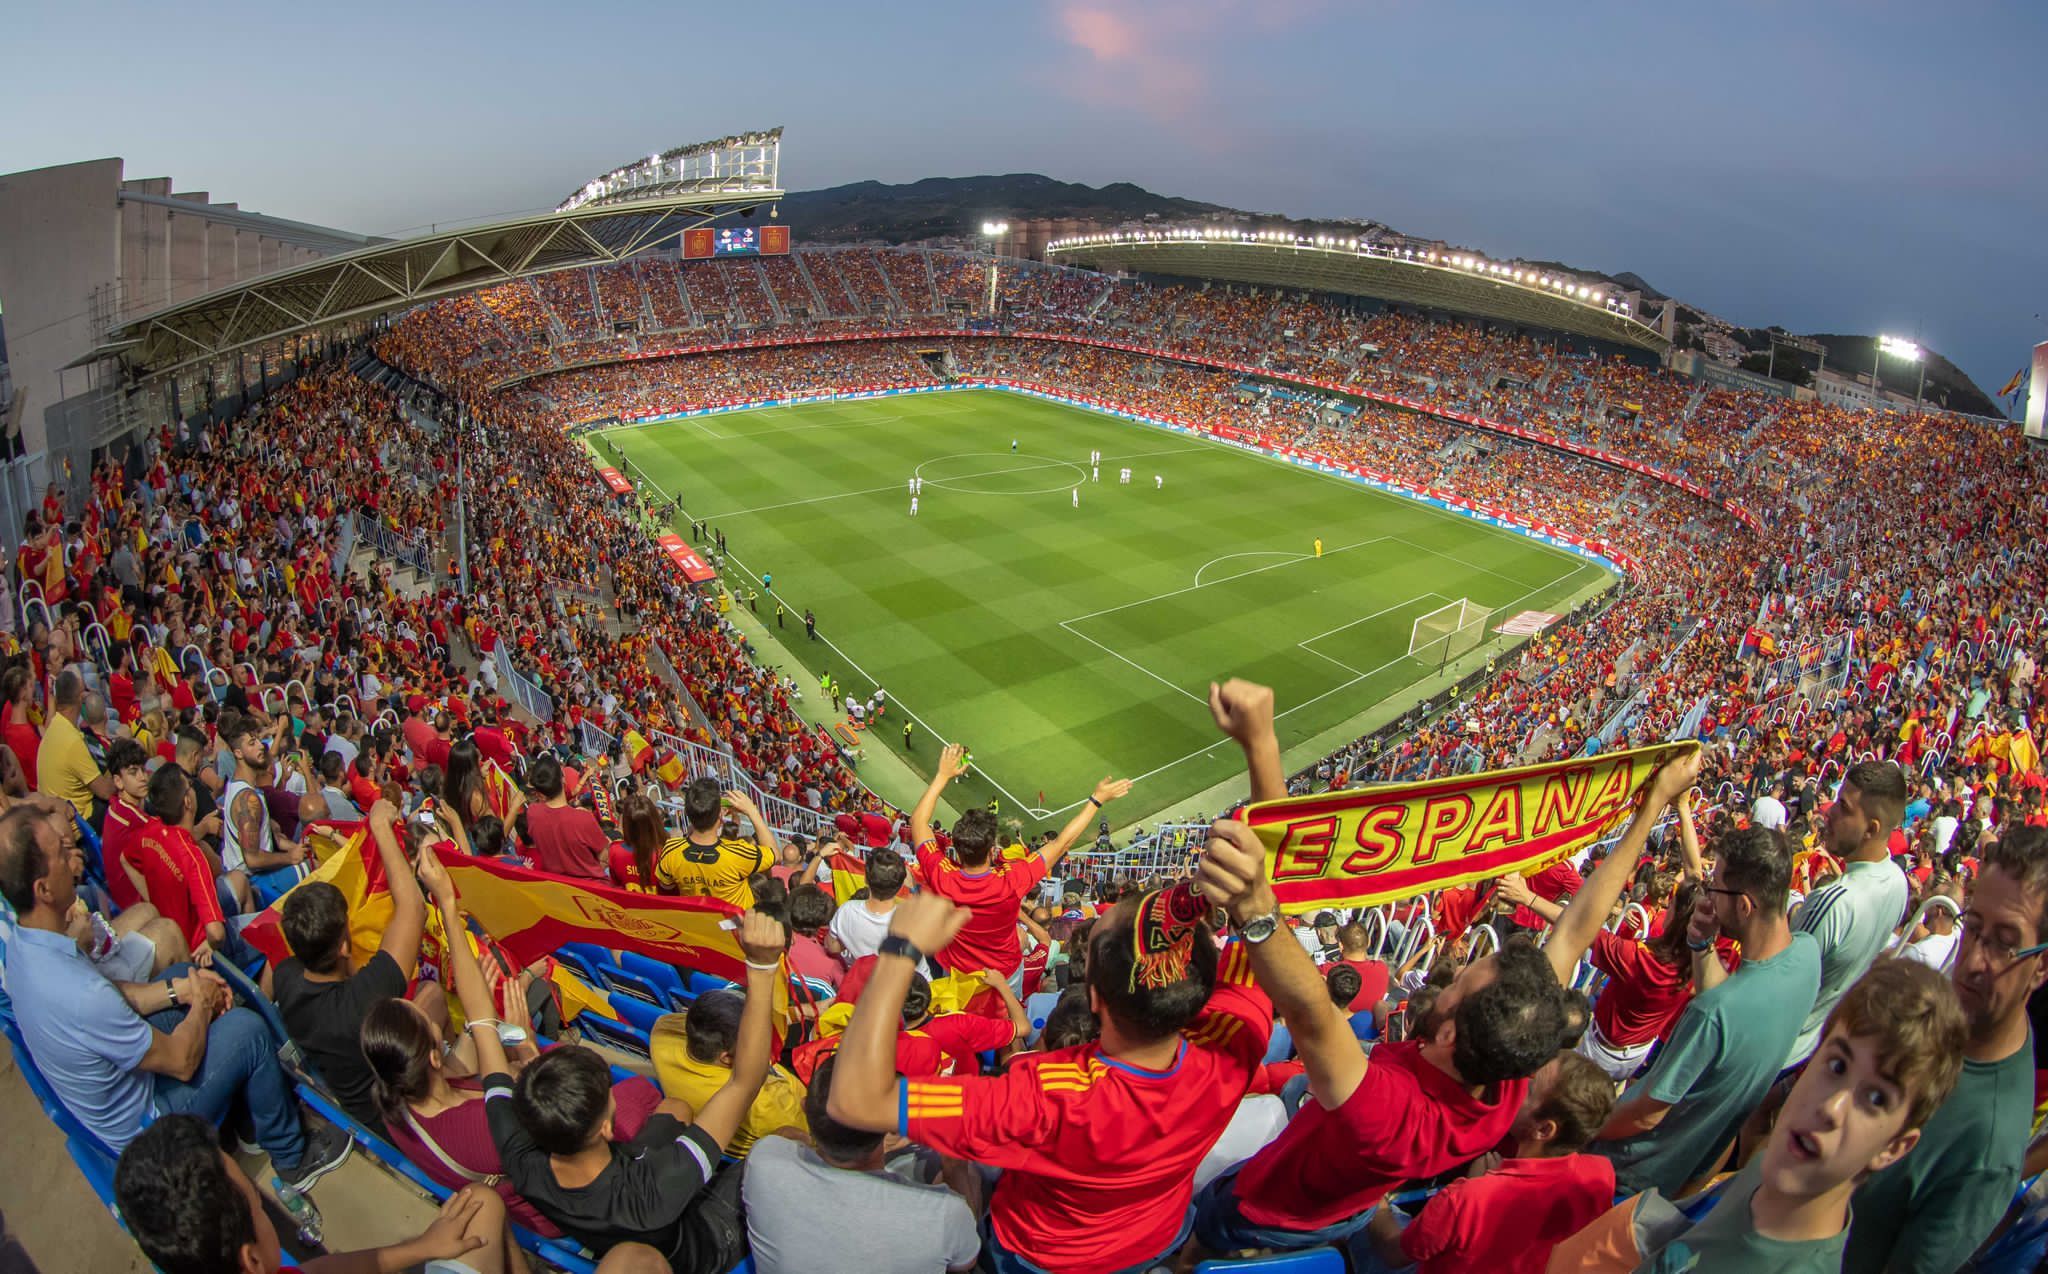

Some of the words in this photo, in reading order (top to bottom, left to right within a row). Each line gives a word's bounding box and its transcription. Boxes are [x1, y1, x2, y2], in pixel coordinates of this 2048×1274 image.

[1221, 437, 1243, 448] NATIONS
[1244, 442, 1263, 454] LEAGUE
[1272, 757, 1635, 882] ESPAÑA
[626, 864, 641, 876] SIL
